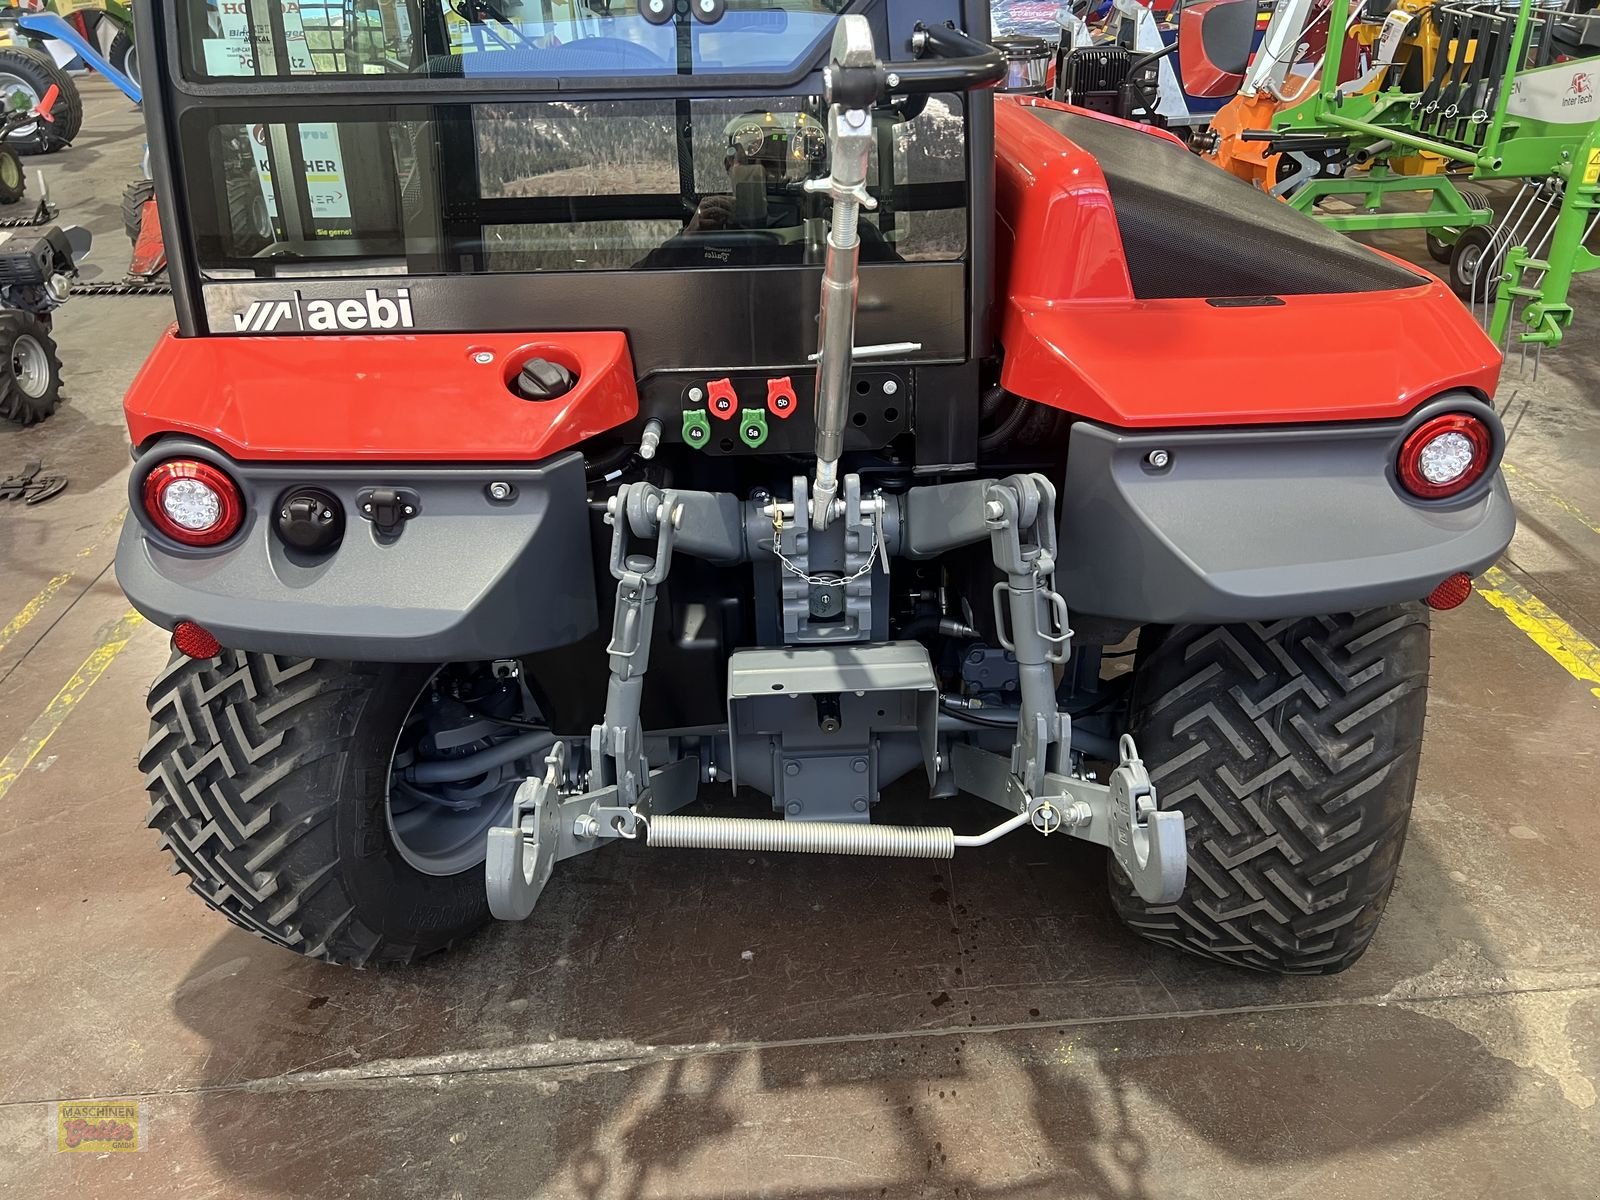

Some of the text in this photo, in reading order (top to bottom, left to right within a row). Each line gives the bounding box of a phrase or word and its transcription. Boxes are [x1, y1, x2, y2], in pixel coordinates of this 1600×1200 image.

[221, 2, 299, 14] HOA
[307, 288, 414, 330] aebi
[718, 400, 729, 408] 4b
[777, 399, 788, 407] 5b
[691, 429, 702, 437] 4a
[748, 428, 759, 437] 5a
